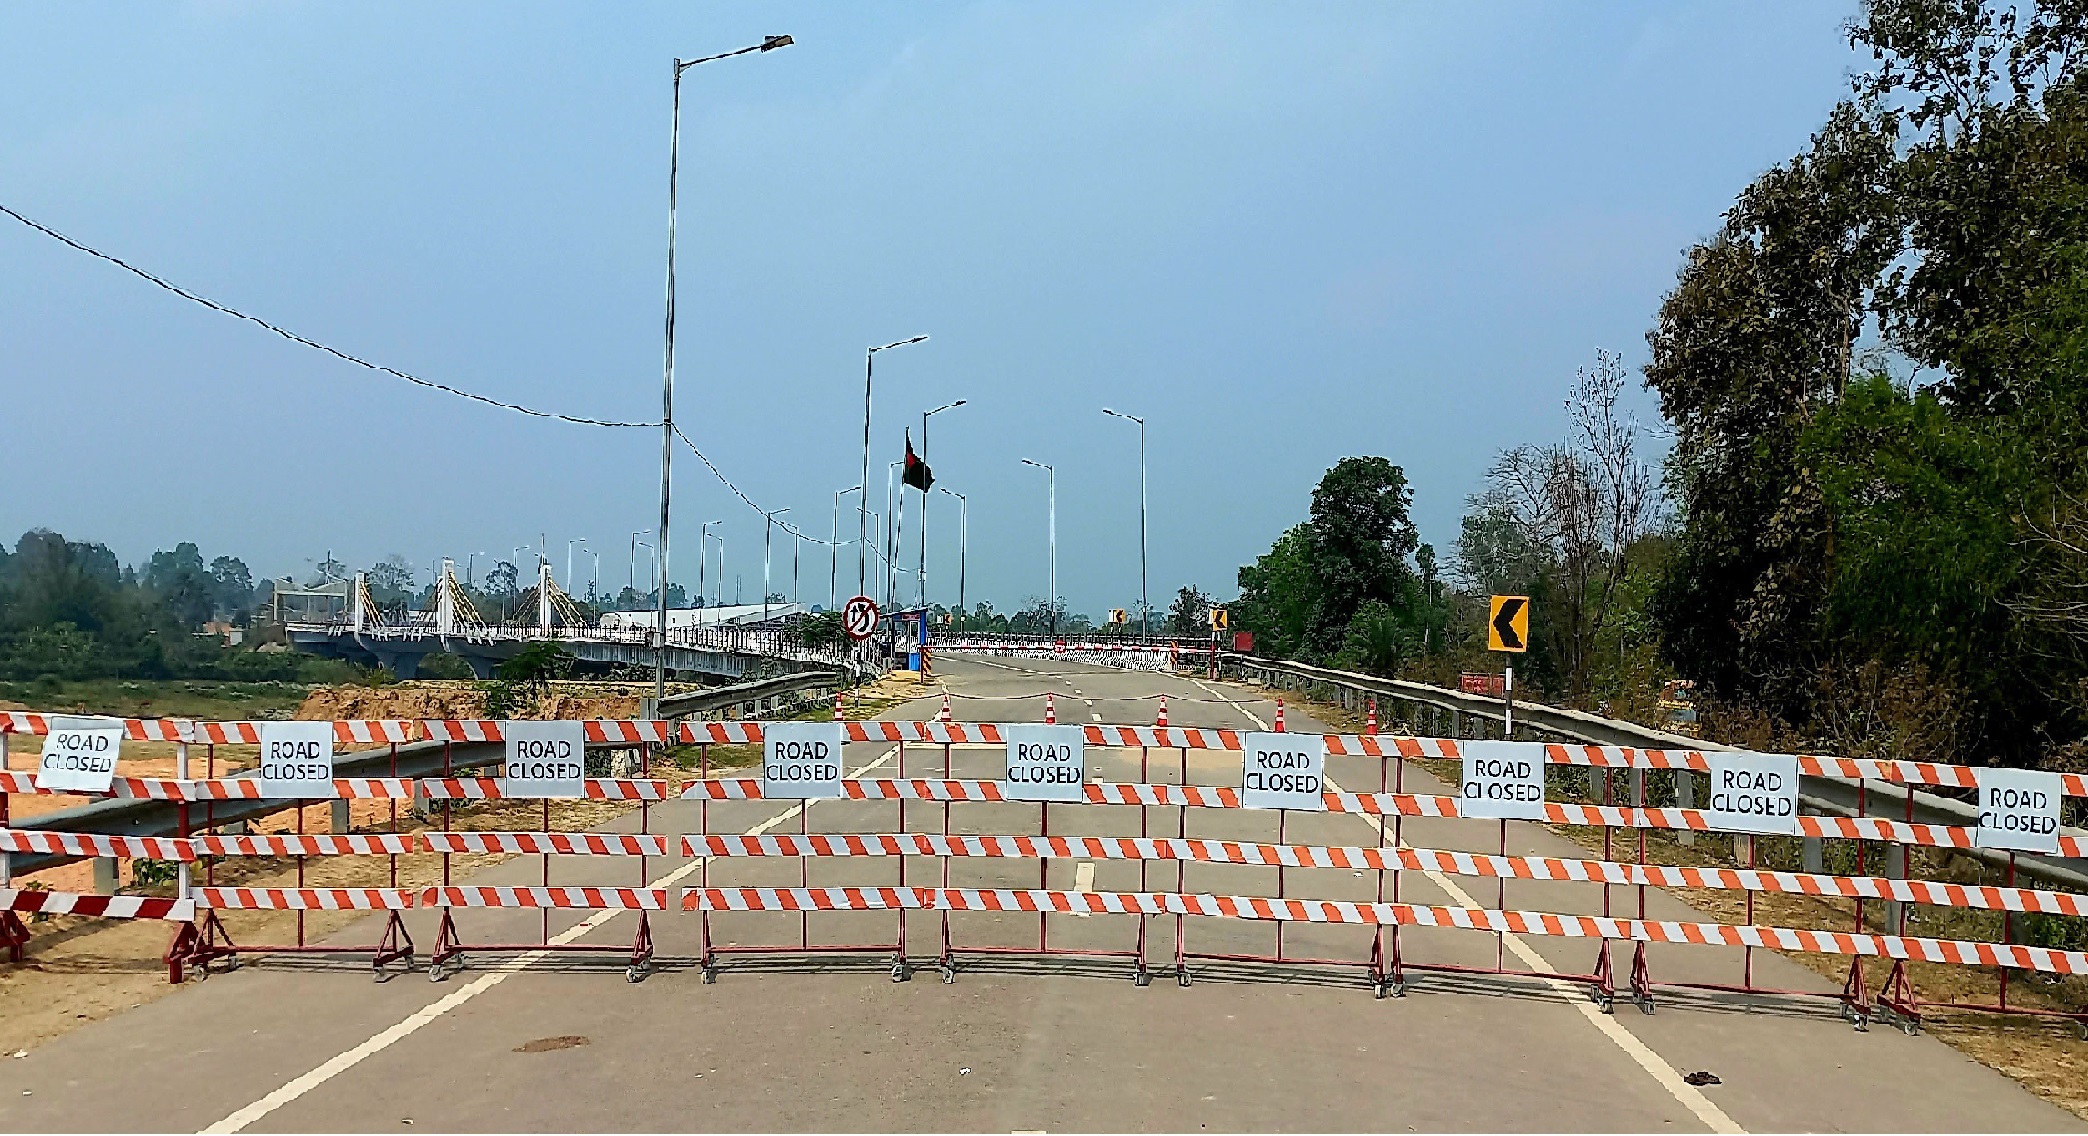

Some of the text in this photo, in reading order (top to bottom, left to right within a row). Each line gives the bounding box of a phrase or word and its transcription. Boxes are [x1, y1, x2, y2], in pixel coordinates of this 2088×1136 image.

[57, 733, 109, 752] ROAD
[270, 741, 320, 759] ROAD
[516, 740, 571, 759] ROAD
[775, 741, 829, 760] ROAD
[1018, 743, 1071, 762] ROAD
[1256, 751, 1310, 770] ROAD
[43, 753, 112, 773] CLOSED
[262, 763, 329, 780] CLOSED
[508, 763, 581, 779] CLOSED
[1475, 759, 1531, 779] ROAD
[1475, 760, 1531, 780] ROAD
[766, 764, 838, 782] CLOSED
[1008, 766, 1081, 784] CLOSED
[1246, 773, 1319, 794] CLOSED
[1463, 781, 1541, 802] CLOSED
[1712, 793, 1792, 816] CLOSED
[1990, 787, 2047, 809] ROAD
[1979, 812, 2057, 835] CLOSED
